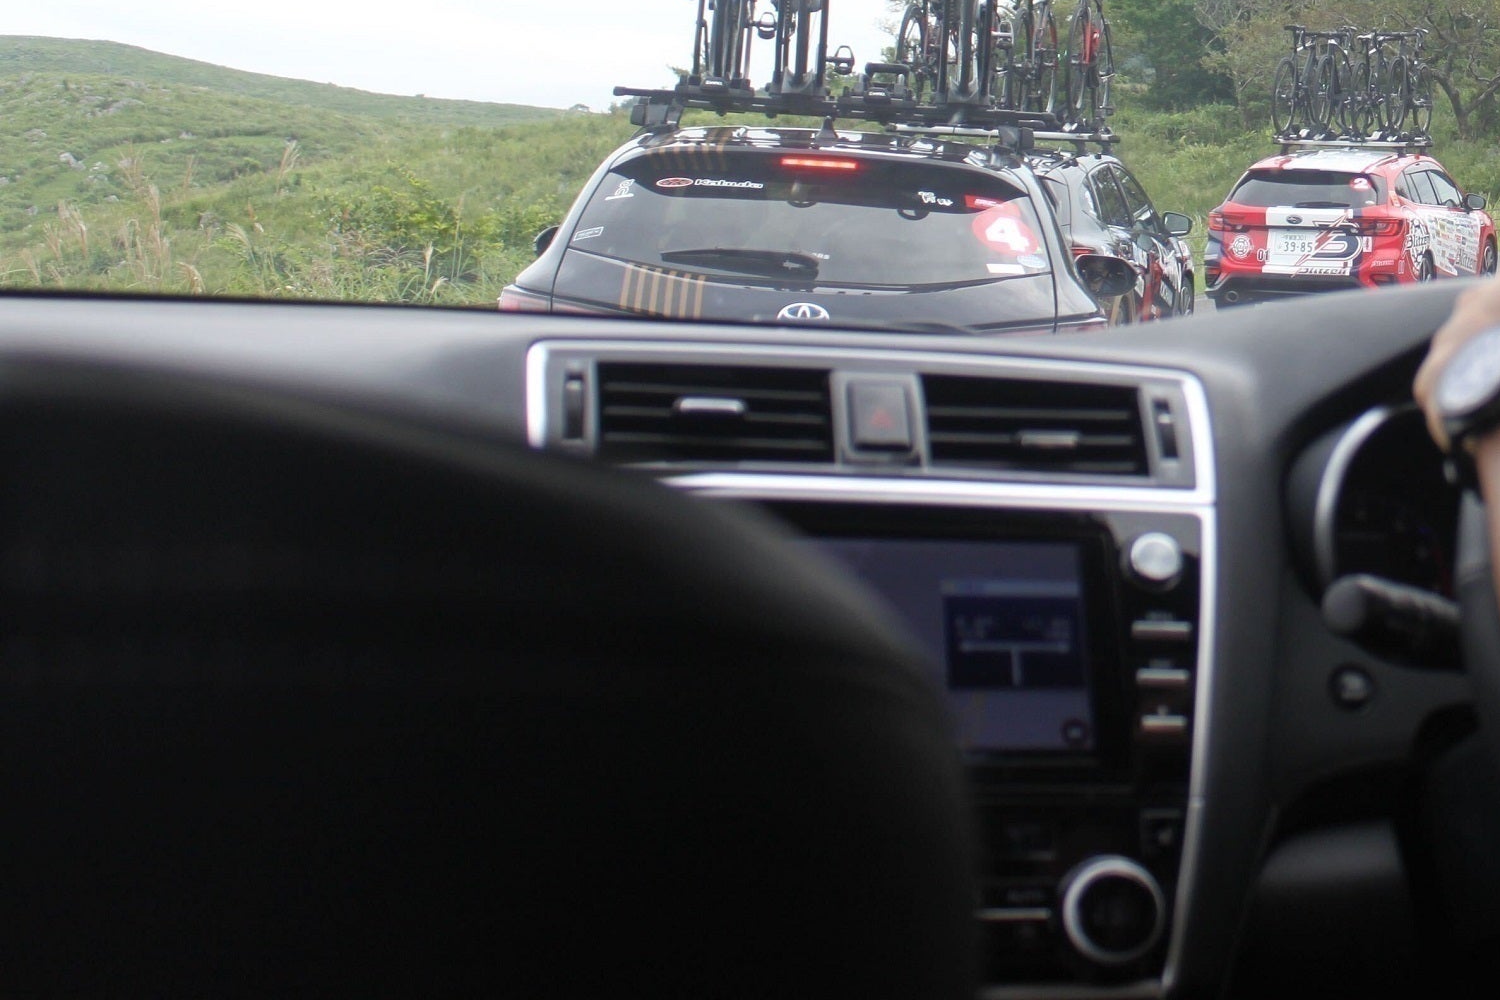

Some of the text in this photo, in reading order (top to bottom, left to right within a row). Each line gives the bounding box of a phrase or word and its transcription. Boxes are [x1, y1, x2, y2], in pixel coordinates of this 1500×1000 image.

[1353, 177, 1370, 190] 2
[985, 217, 1030, 252] 4
[1283, 241, 1313, 253] 39-85
